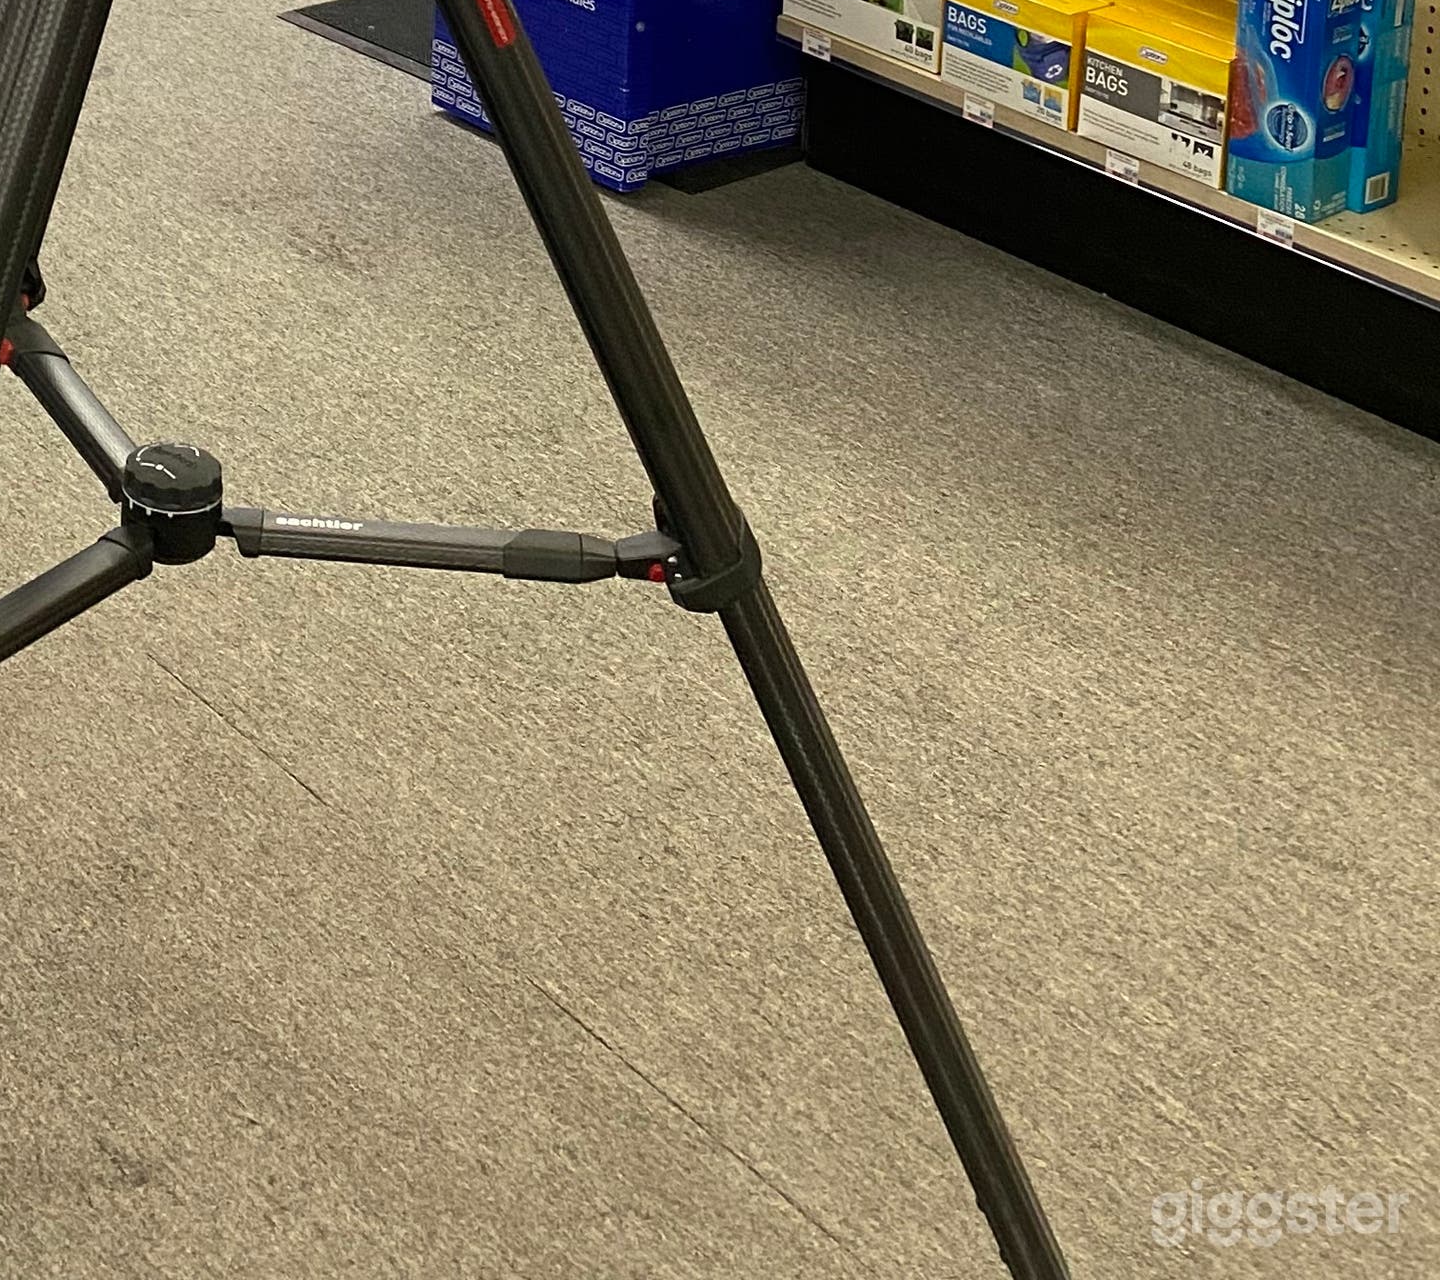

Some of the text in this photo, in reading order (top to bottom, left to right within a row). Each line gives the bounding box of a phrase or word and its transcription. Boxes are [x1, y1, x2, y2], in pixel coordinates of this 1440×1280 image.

[947, 6, 987, 34] BAGS
[915, 48, 933, 62] bags
[1087, 55, 1124, 77] KITCHEN
[1085, 66, 1129, 96] BAGS
[1193, 164, 1212, 177] bags
